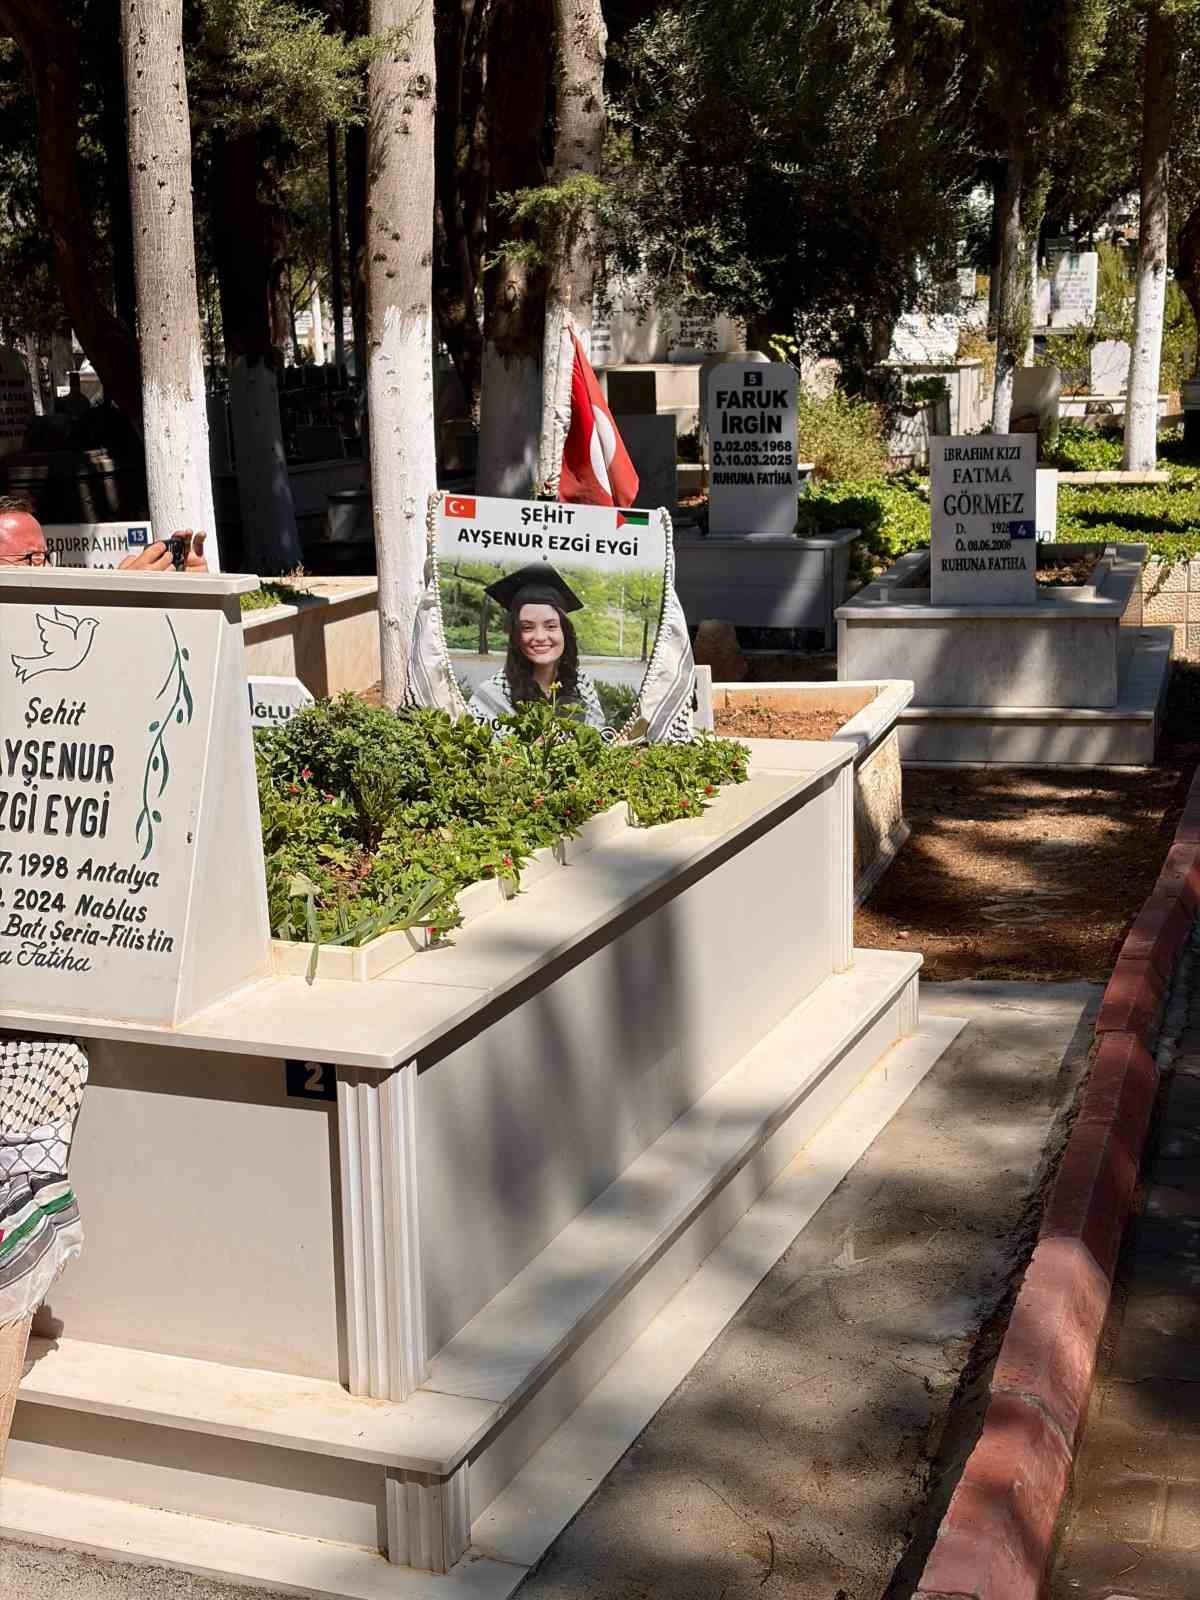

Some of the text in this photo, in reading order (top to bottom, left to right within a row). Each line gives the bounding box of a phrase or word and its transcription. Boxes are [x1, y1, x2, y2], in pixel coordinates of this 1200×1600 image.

[716, 390, 788, 409] FARUK
[721, 411, 782, 434] İRGİN
[996, 446, 1021, 460] KIZI
[712, 470, 793, 486] RUHUNA FATİHA
[952, 466, 1013, 484] FATMA
[521, 505, 576, 525] ŞEHİT
[943, 491, 1025, 516] GÖRMEZ
[46, 535, 129, 552] BDURRAHIM
[131, 530, 145, 542] 13
[458, 528, 638, 556] AYŞENUR EZGİ EYGİ
[942, 557, 986, 572] RUHUNA
[25, 696, 86, 728] Şehit
[254, 701, 290, 720] ĞLU
[0, 738, 114, 786] YŞENUR
[0, 784, 110, 839] ZGİ EYGİ
[76, 858, 160, 894] Antalya
[75, 894, 148, 923] Nablus
[17, 941, 92, 972] Fatiha
[304, 1061, 325, 1092] 2
